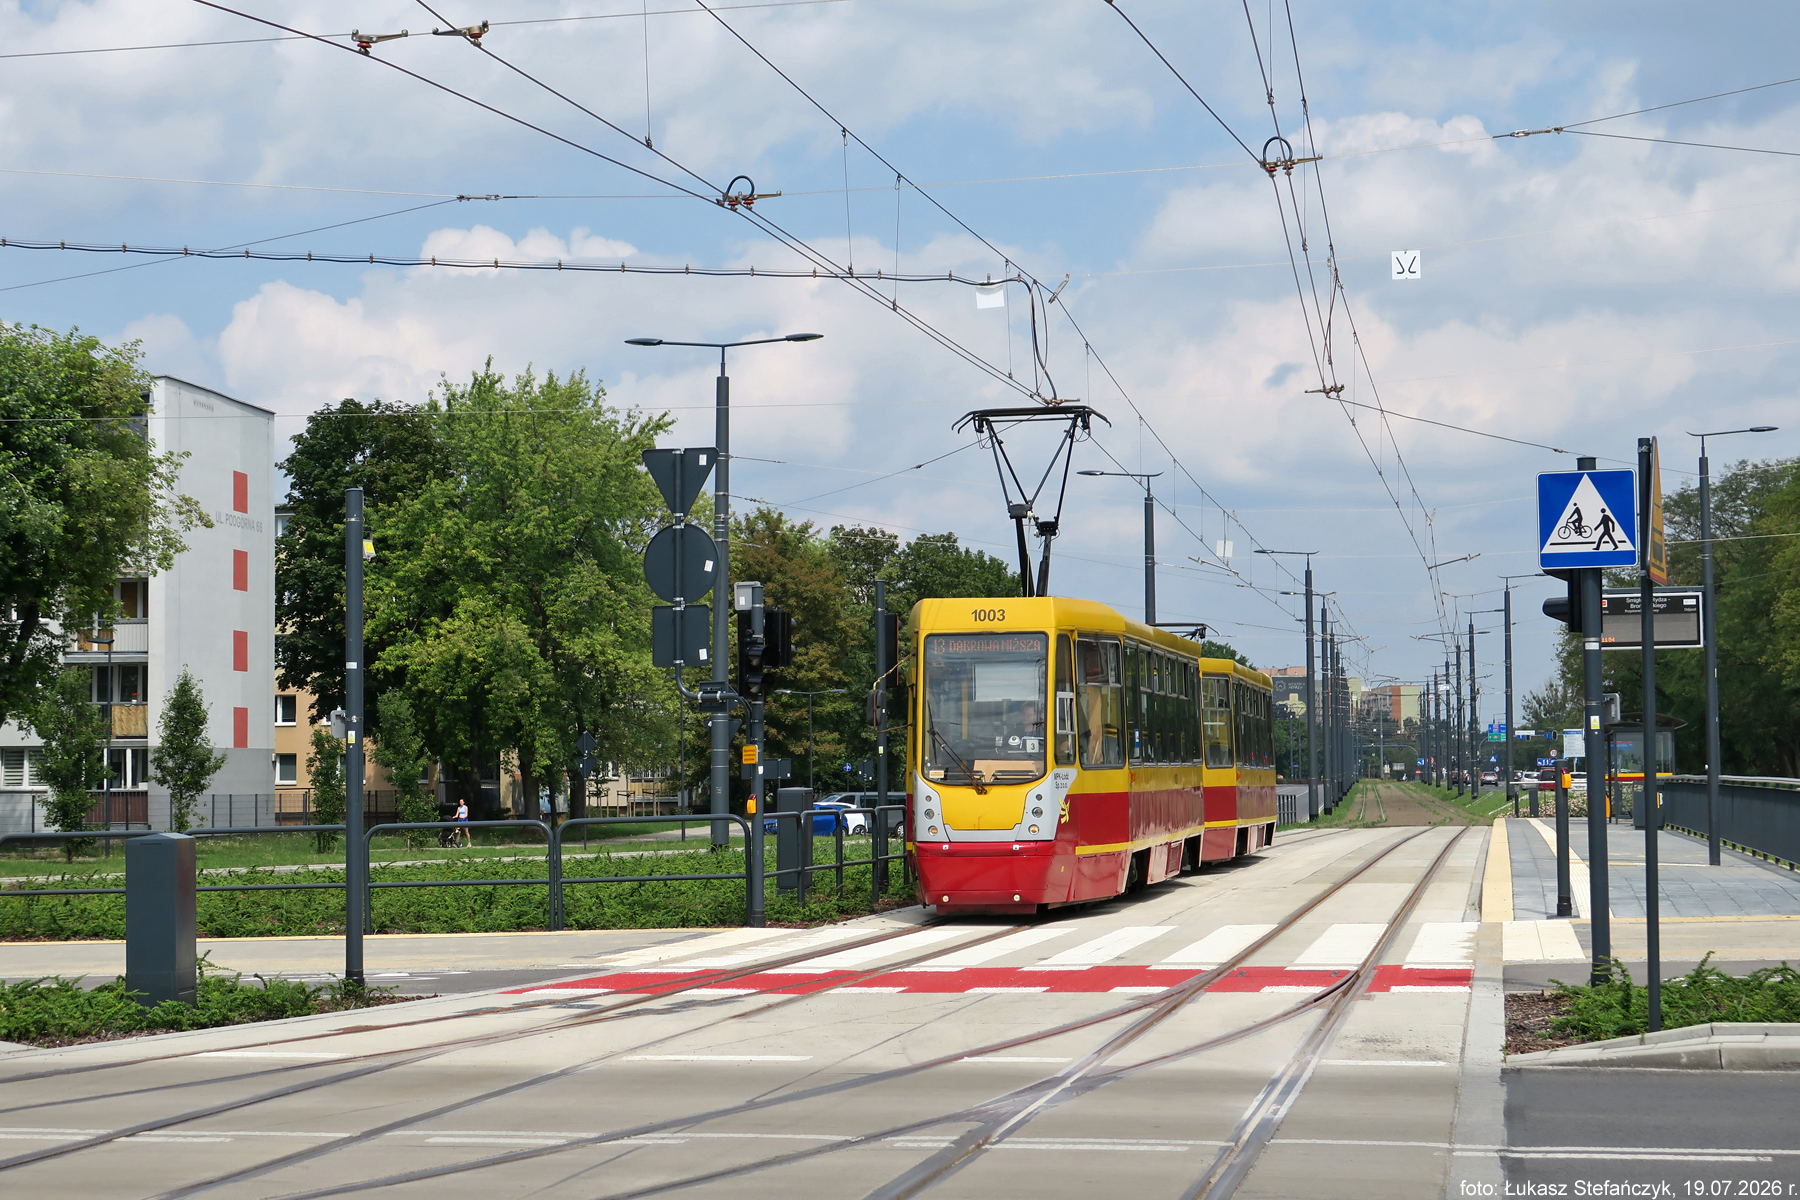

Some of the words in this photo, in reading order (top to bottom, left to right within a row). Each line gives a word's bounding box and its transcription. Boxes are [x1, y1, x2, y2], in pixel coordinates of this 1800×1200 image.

[971, 608, 1006, 622] 1003
[933, 638, 946, 655] 13
[949, 640, 1000, 654] DĄBROWA
[1001, 637, 1041, 652] NIŻSZA
[1030, 742, 1036, 751] 3
